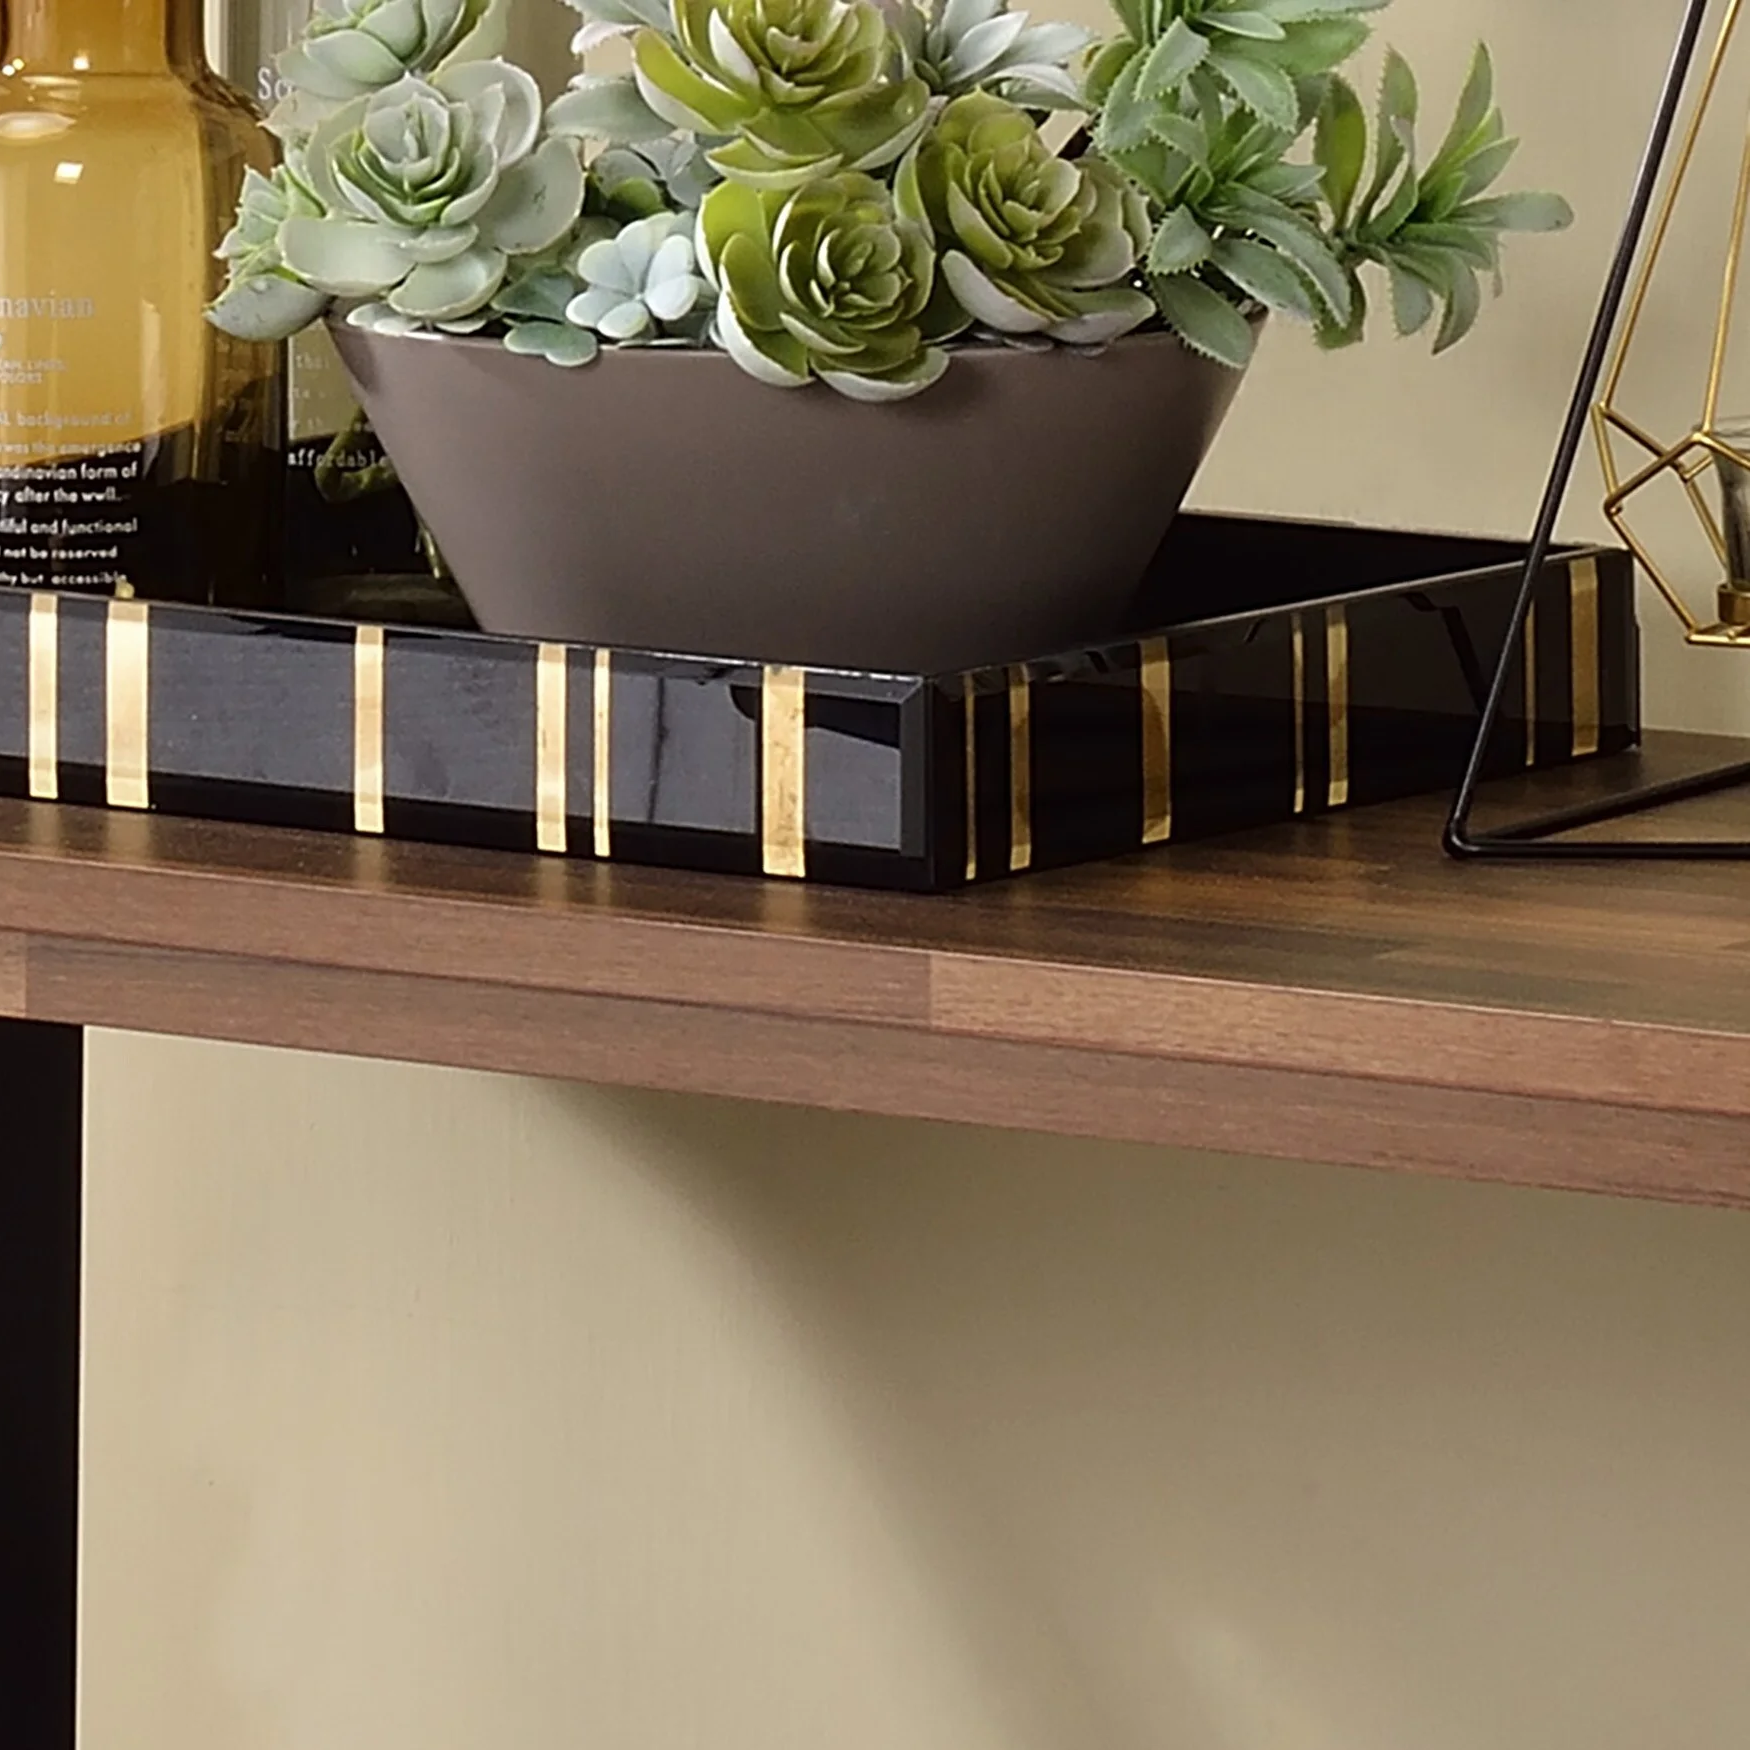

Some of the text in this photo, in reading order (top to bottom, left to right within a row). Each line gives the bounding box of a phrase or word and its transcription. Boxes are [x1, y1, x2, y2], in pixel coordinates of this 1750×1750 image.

[81, 462, 118, 480] form
[121, 461, 138, 478] of
[14, 486, 50, 503] after
[53, 488, 78, 503] the
[30, 519, 59, 534] and
[61, 518, 138, 537] functional
[3, 546, 27, 560] not
[29, 546, 48, 560] be
[51, 545, 118, 560] reserved
[20, 571, 44, 585] but
